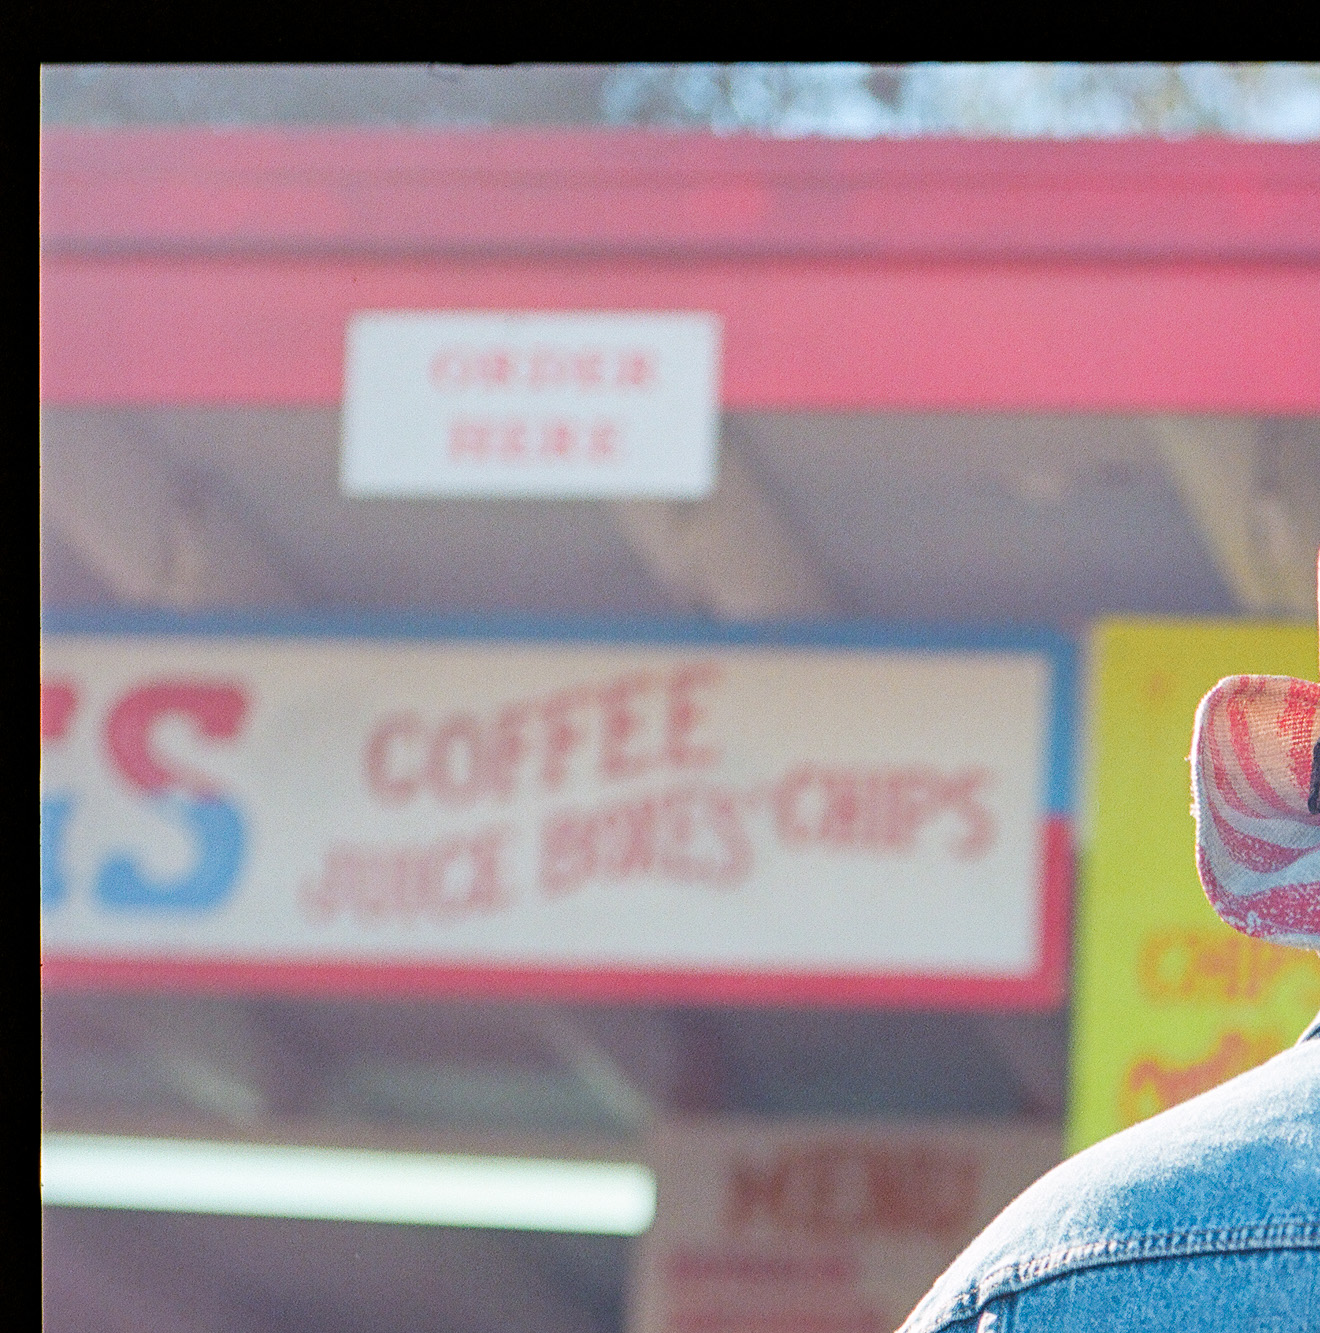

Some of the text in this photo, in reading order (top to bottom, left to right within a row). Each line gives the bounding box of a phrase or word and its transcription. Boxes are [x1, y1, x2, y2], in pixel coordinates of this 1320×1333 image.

[40, 672, 252, 915] S
[360, 660, 725, 810] COFFEE
[773, 760, 1000, 862] CHIPS
